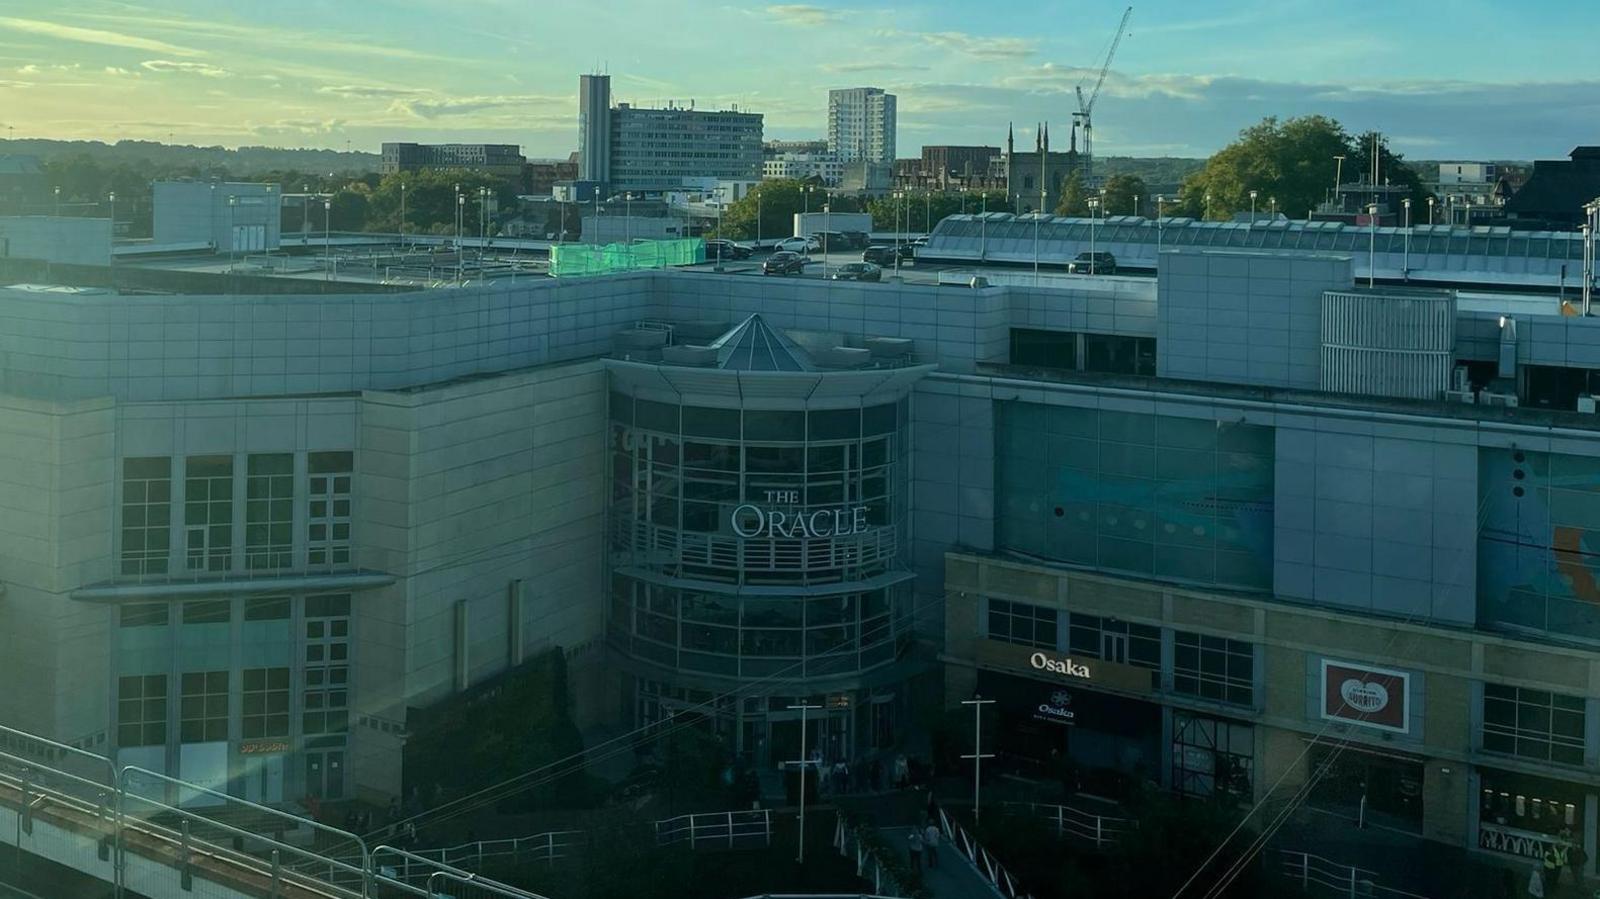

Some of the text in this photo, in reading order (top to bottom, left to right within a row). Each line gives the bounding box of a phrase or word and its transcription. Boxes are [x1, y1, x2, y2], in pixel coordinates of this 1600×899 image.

[763, 490, 799, 503] THE
[731, 504, 869, 538] ORACLE
[1030, 652, 1091, 678] Osaka
